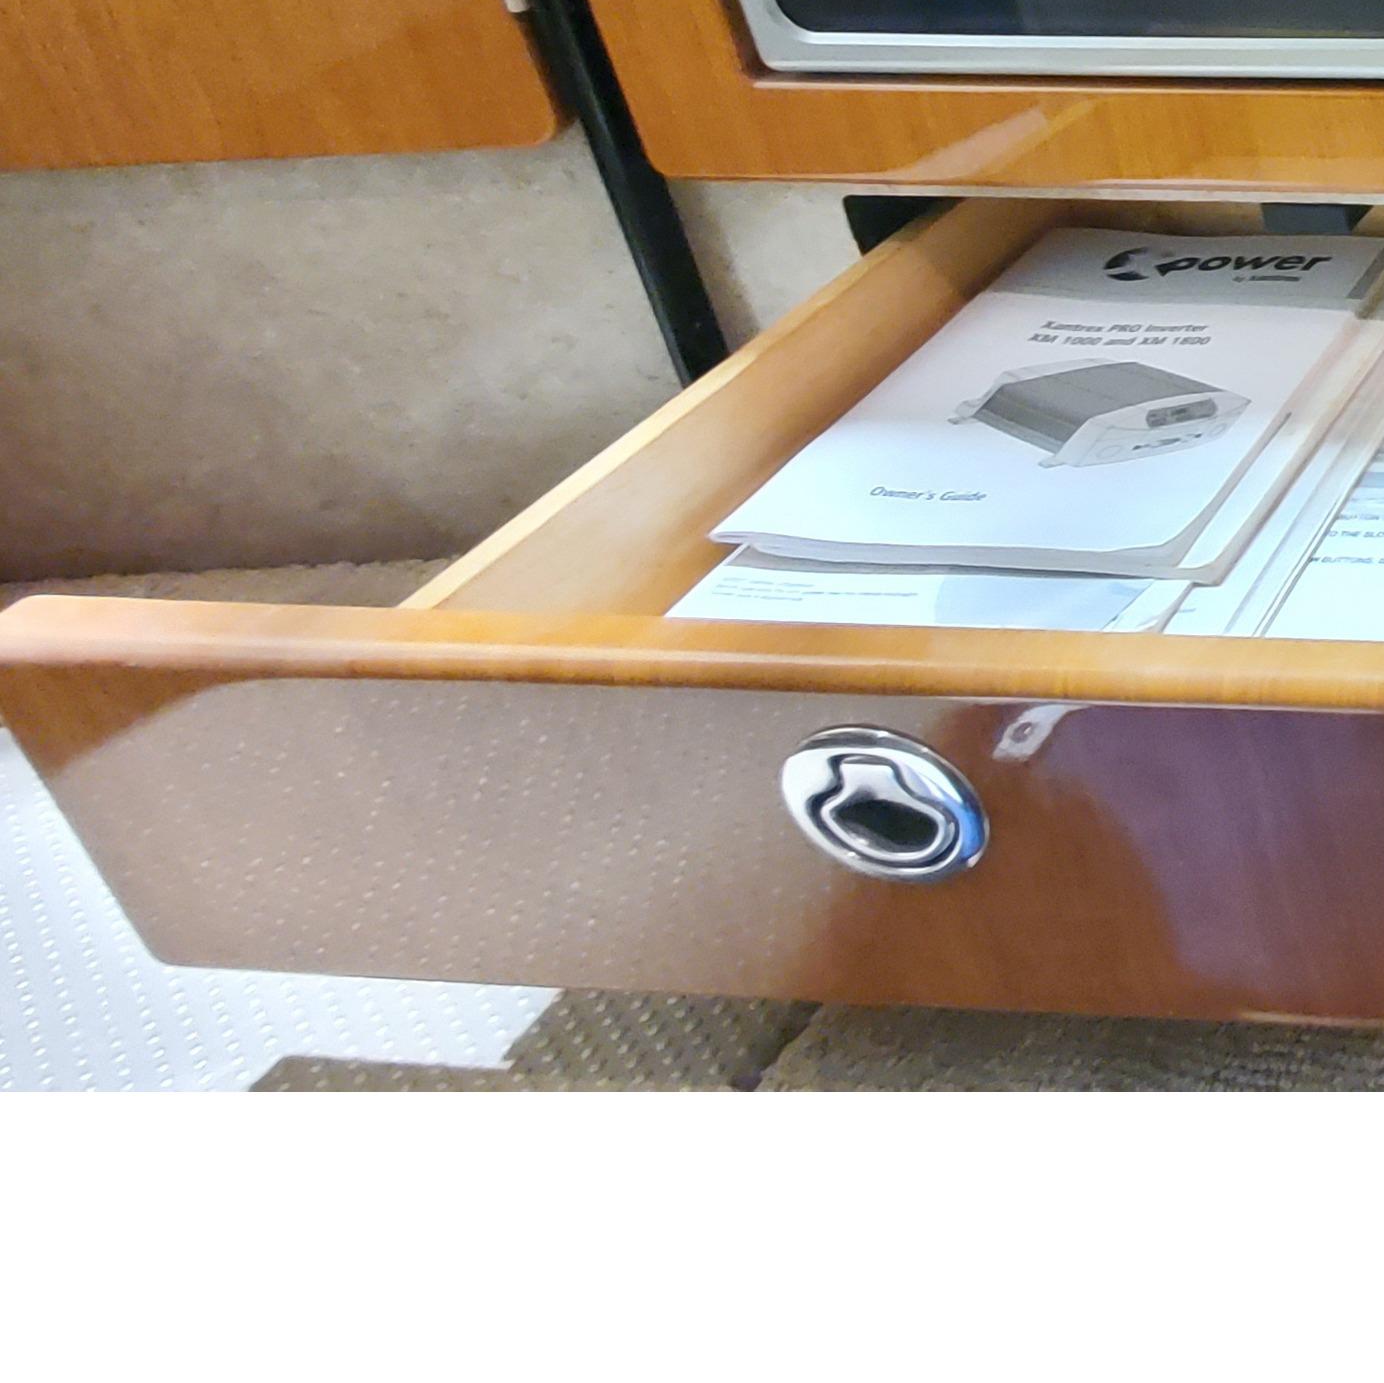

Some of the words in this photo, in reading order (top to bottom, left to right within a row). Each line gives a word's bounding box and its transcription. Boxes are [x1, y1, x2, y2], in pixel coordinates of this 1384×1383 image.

[1107, 324, 1143, 333] PRO
[1028, 333, 1058, 343] XM
[1138, 336, 1168, 345] XM
[870, 486, 936, 501] Owner's
[939, 490, 988, 501] Guide
